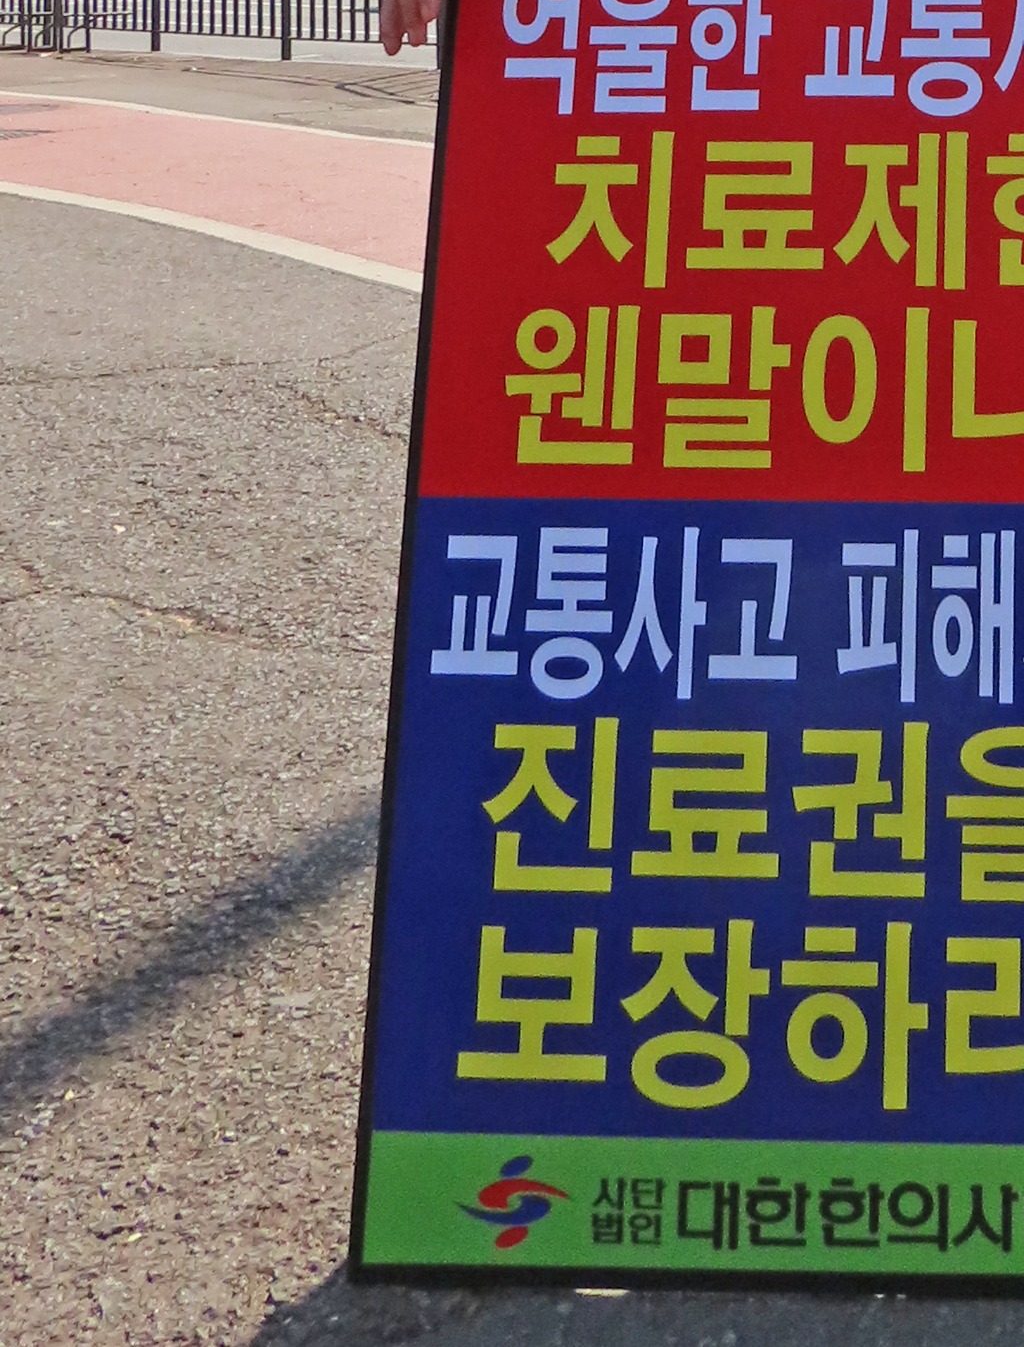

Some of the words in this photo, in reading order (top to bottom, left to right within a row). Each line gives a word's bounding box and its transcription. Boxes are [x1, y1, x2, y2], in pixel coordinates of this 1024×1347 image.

[430, 526, 798, 699] 교통사고
[591, 1176, 667, 1210] 사단
[590, 1210, 664, 1246] 법인
